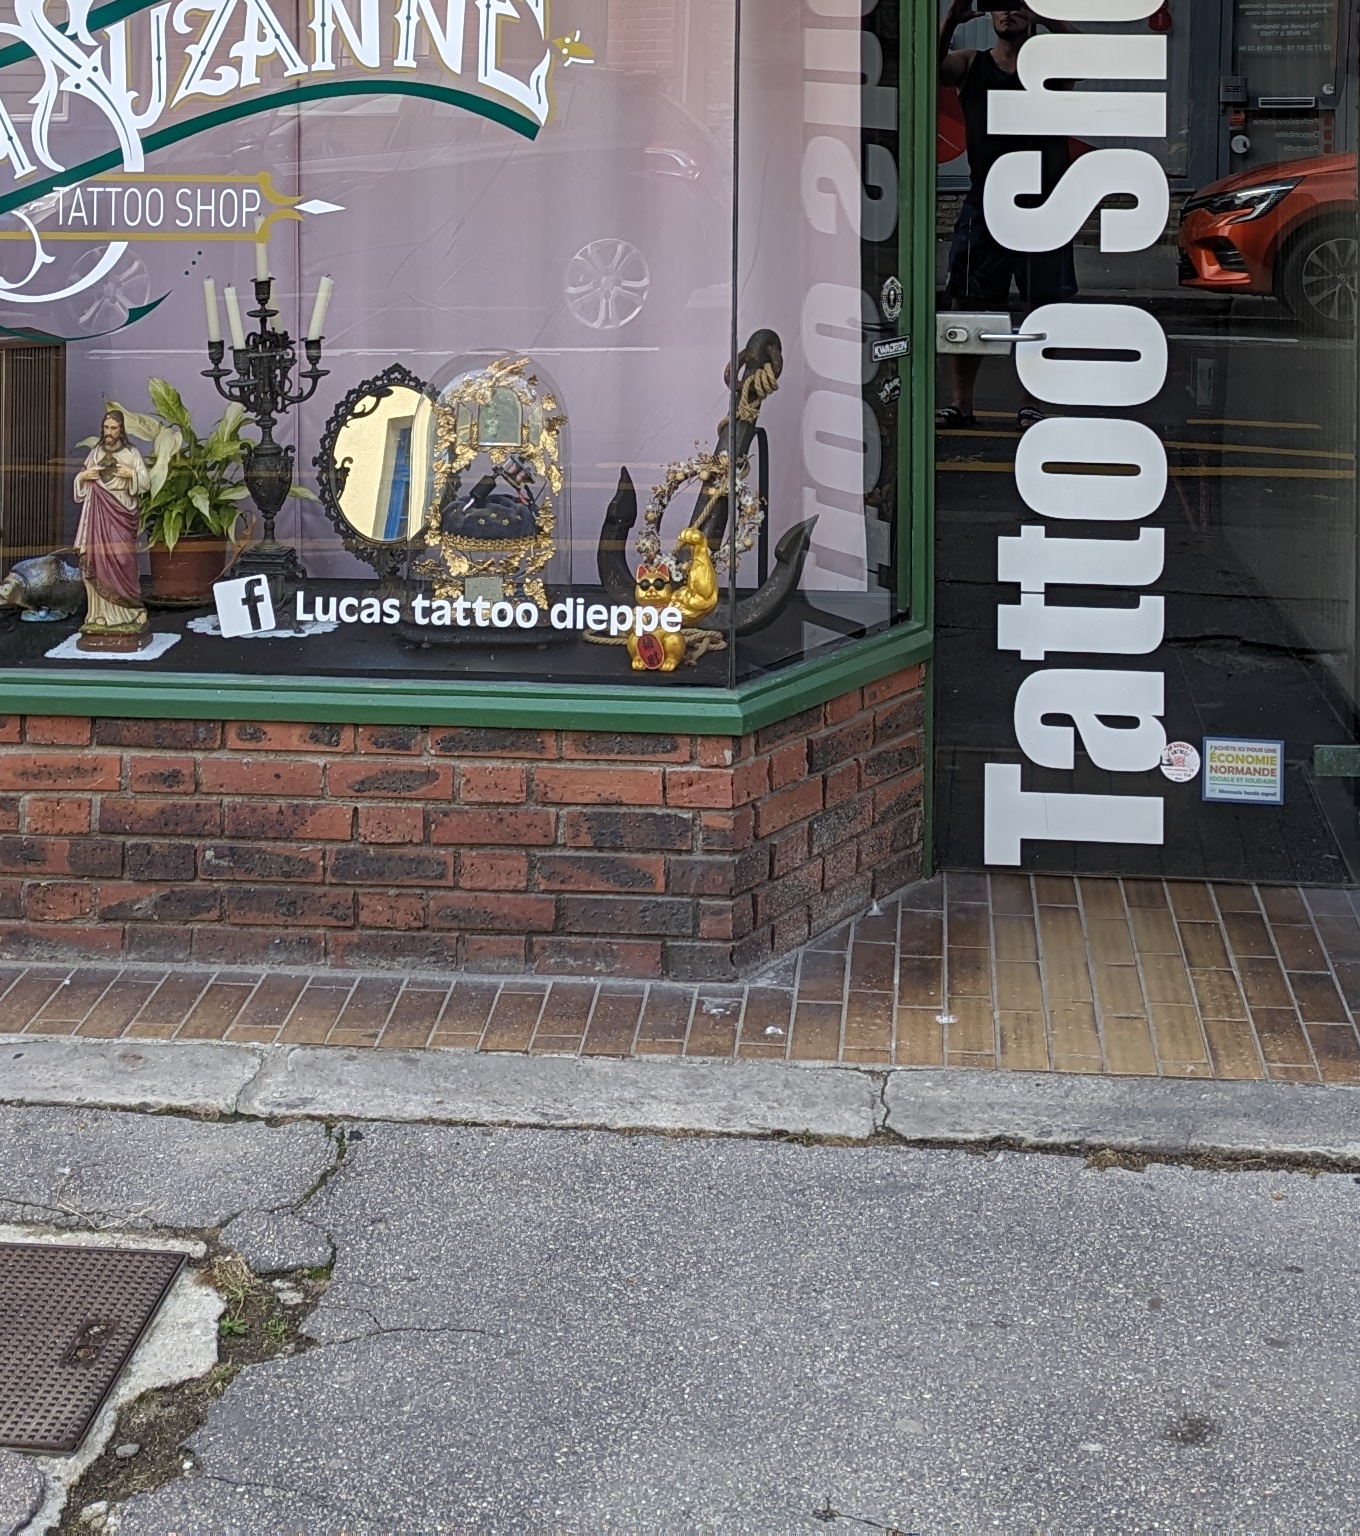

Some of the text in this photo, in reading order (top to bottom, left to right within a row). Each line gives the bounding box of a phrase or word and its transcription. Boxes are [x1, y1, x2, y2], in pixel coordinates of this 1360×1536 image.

[53, 187, 262, 230] TATTOO SHOP
[984, 303, 1168, 866] Tattoo
[295, 591, 401, 624] Lucas
[412, 592, 545, 627] tattoo
[549, 595, 682, 637] dieppe
[1209, 765, 1277, 777] NORMANDE
[1210, 751, 1277, 765] ÉCONOMIE
